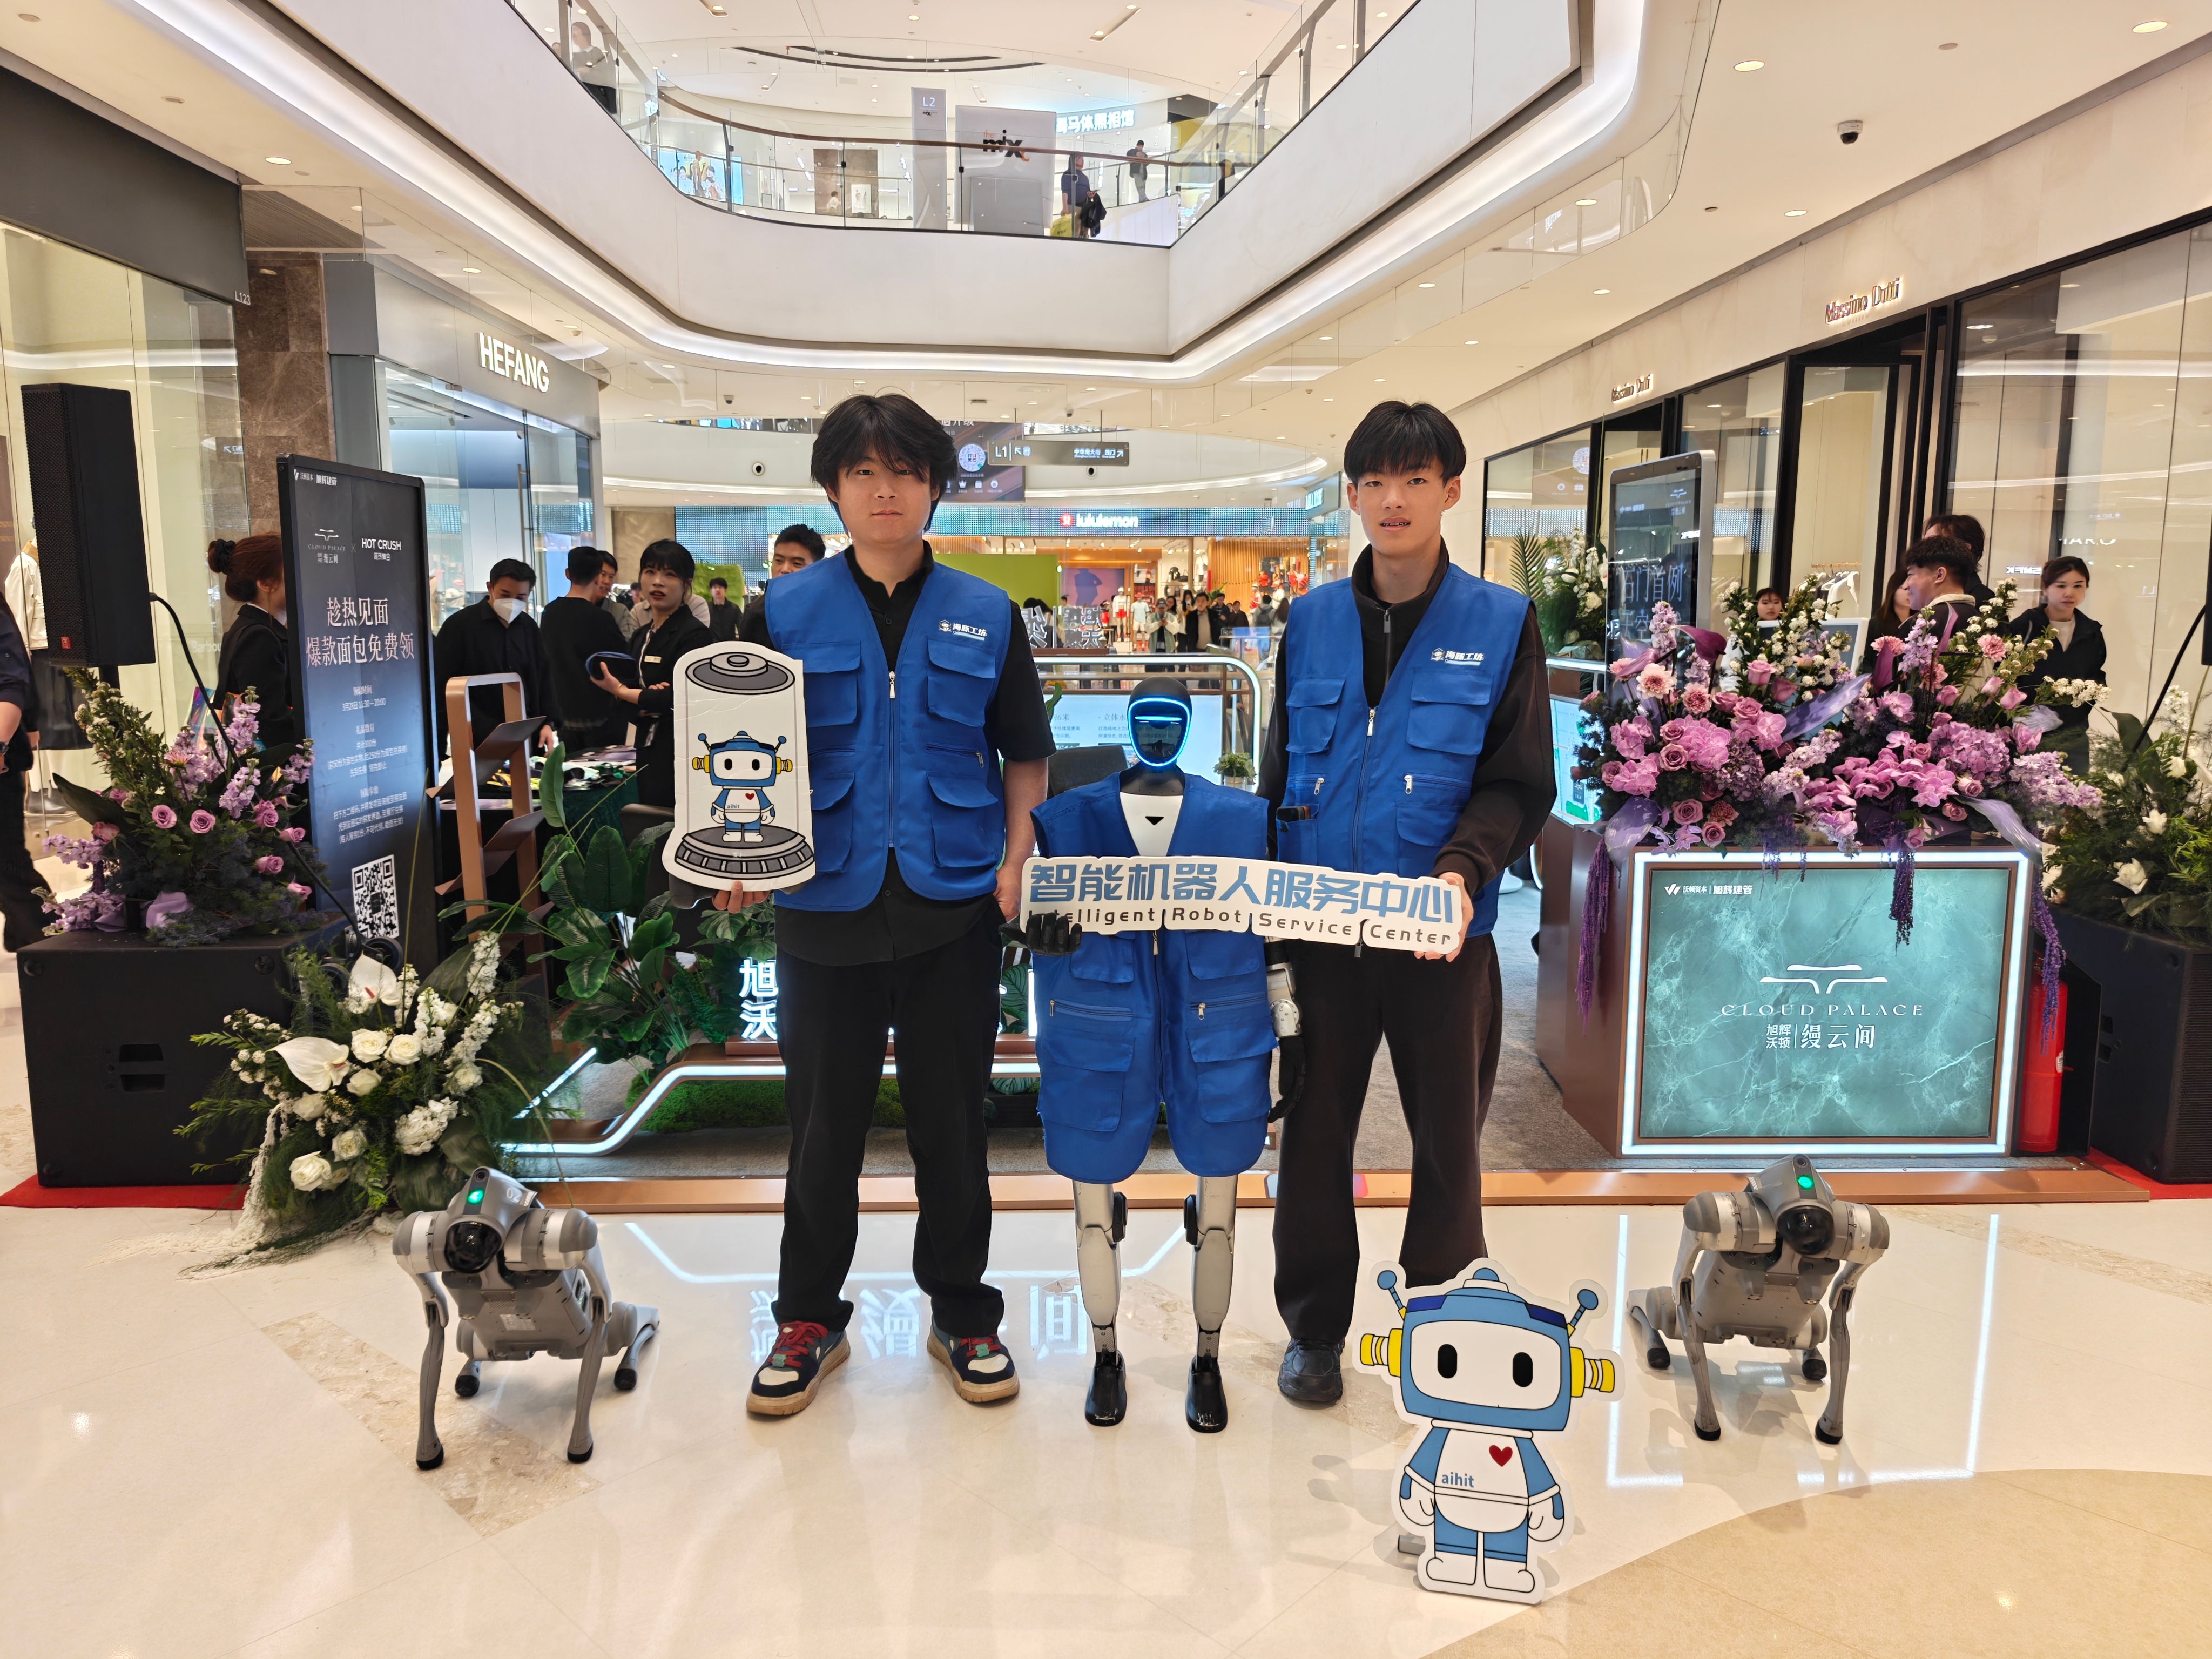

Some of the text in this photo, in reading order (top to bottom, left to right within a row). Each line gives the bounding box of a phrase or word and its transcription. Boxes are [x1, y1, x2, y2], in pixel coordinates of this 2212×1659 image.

[923, 97, 935, 107] L2
[983, 130, 994, 138] the
[235, 291, 251, 306] L123
[1825, 276, 1902, 325] Massimo Dutti
[479, 332, 549, 393] HEFANG
[995, 445, 1007, 457] L1
[1076, 513, 1139, 528] lululemon
[361, 538, 402, 550] HOT CRUSH
[327, 597, 389, 628] 趁热见面
[952, 623, 987, 637] 海豚工坊
[306, 632, 415, 669] 爆款面包免费领
[1445, 650, 1483, 661] 海豚工坊
[1030, 864, 1453, 924] 智能机器人服务中心
[1682, 885, 1754, 895] 沃顿资本 旭辉建管
[1029, 907, 1451, 945] Itelligent Robot Service Center
[1721, 1004, 1923, 1016] CLOUD PALACE
[1766, 1024, 1791, 1036] 旭辉
[1801, 1024, 1876, 1049] 缦云间
[1765, 1037, 1791, 1049] 沃顿
[1441, 1472, 1474, 1488] aihit
